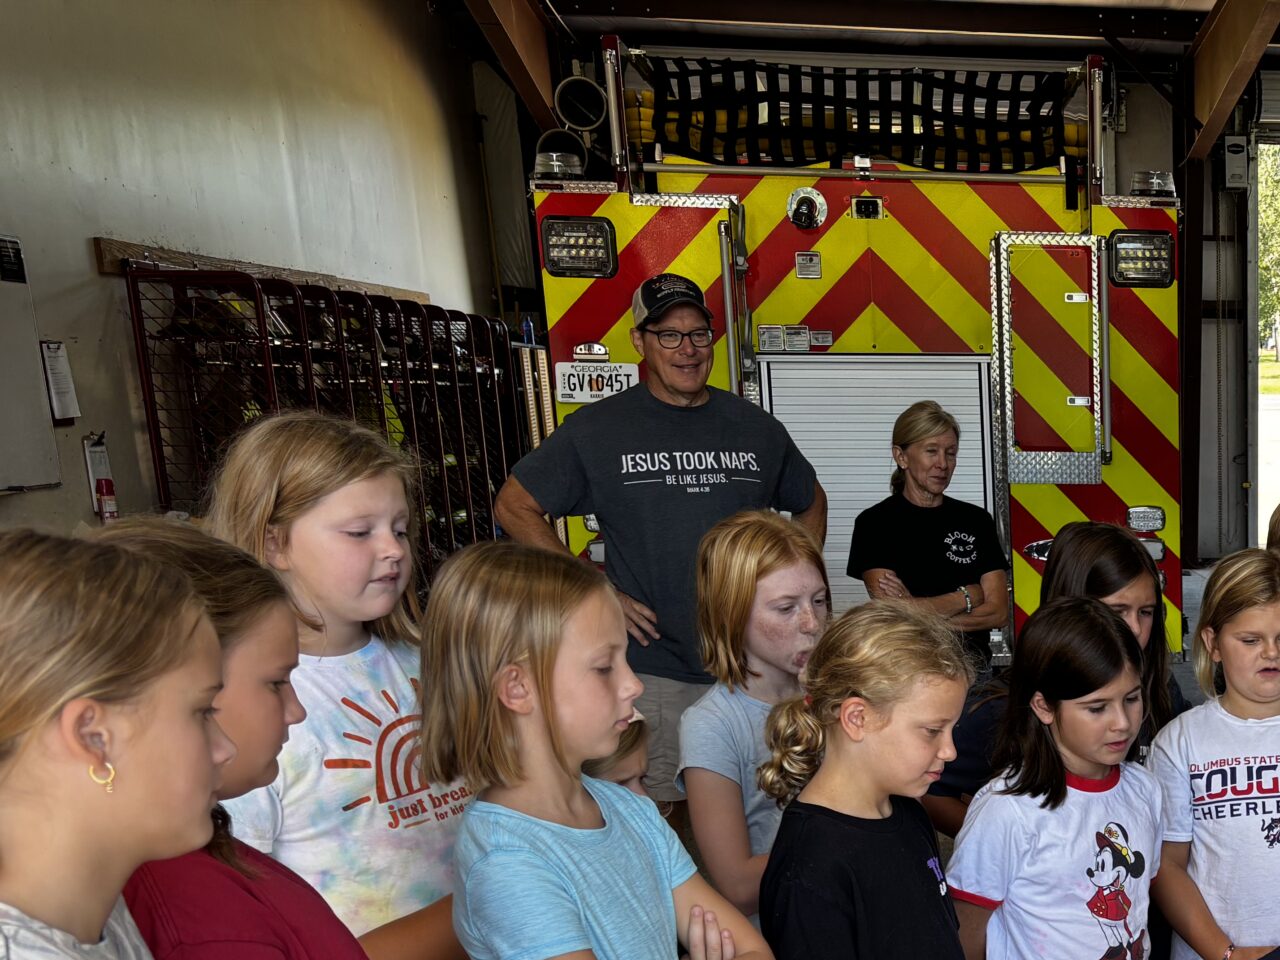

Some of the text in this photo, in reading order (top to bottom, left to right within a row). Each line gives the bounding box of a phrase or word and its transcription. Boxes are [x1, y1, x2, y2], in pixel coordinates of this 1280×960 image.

[574, 365, 619, 373] GEORGIA
[567, 373, 632, 392] GV1045T
[621, 451, 761, 473] JESUS TOOK NAPS.
[665, 473, 729, 485] BE LIKE JESUS.
[943, 531, 976, 545] BLOOM
[946, 551, 972, 564] COFFEE
[387, 798, 428, 829] just
[434, 803, 468, 822] for kid
